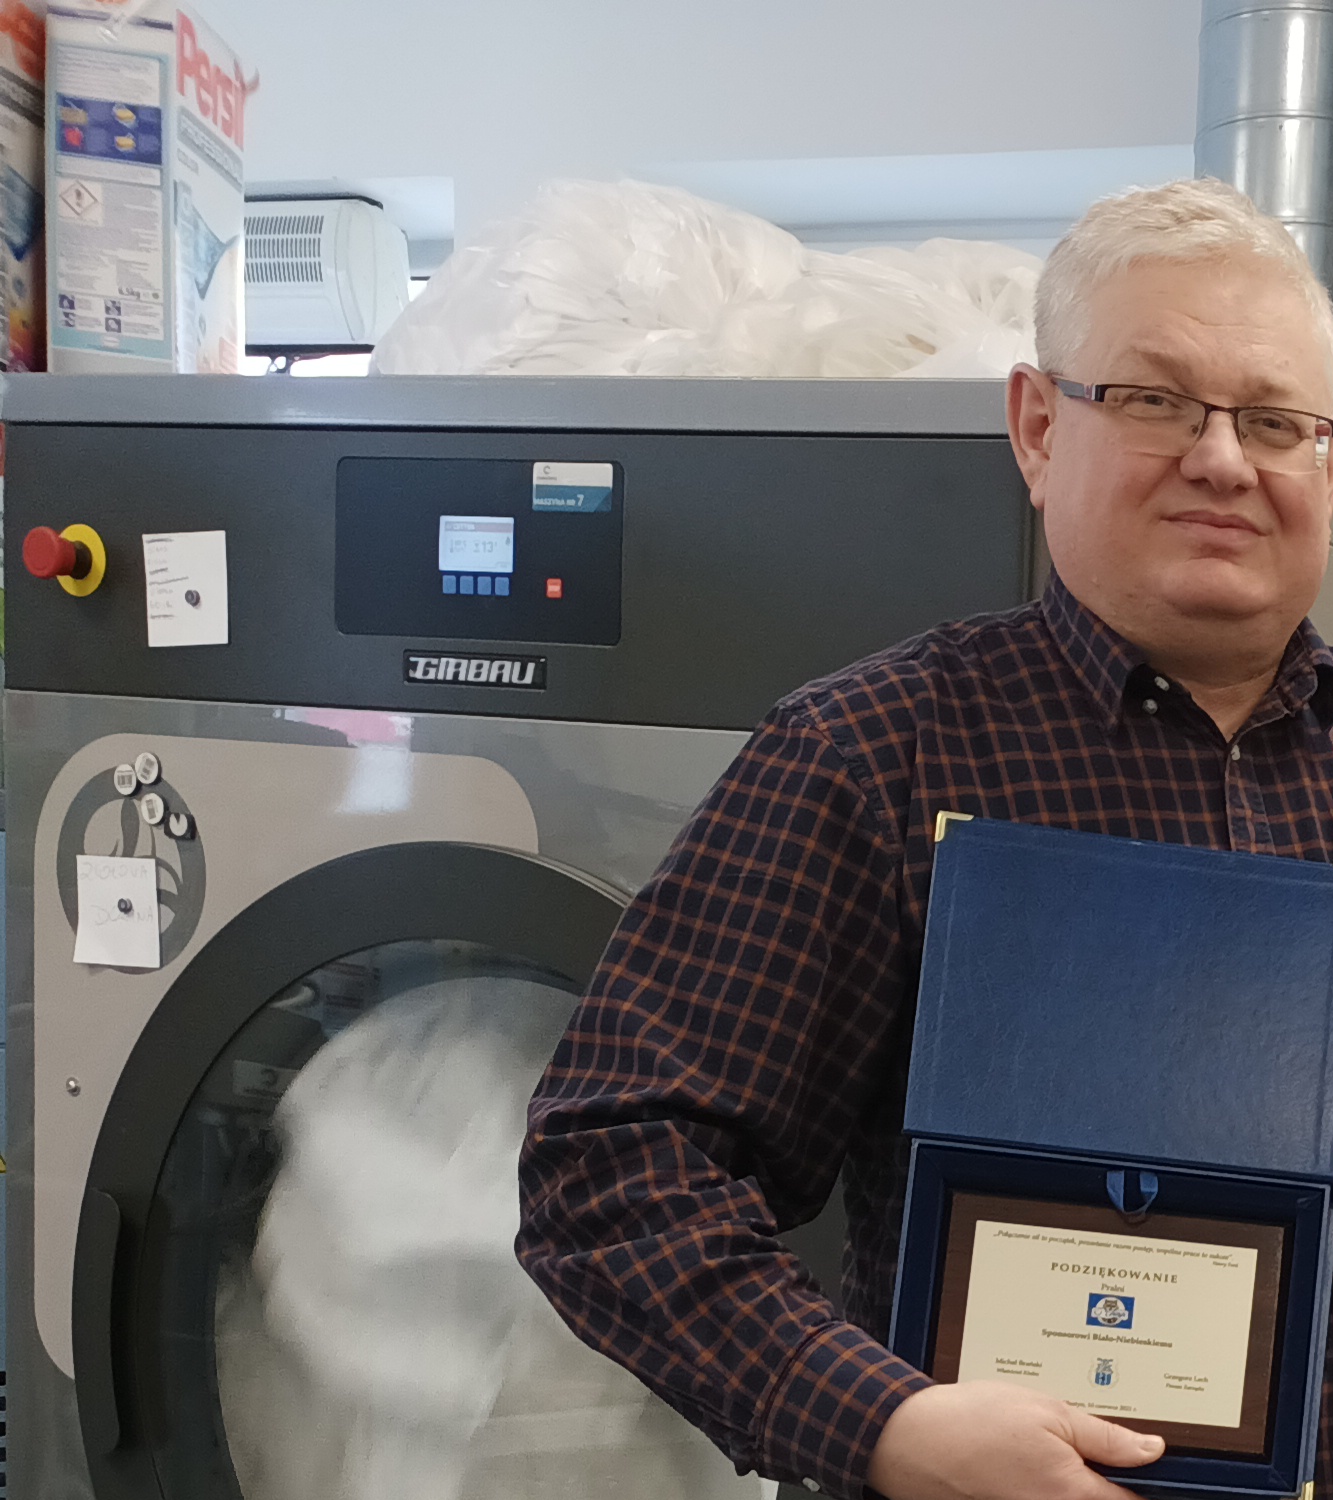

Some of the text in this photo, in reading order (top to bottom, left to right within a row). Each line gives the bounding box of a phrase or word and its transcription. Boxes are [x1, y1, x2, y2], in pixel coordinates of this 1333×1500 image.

[176, 9, 244, 152] Persil
[577, 493, 585, 507] 7
[411, 656, 536, 685] GIRBAU
[1050, 1262, 1178, 1284] PODZIĘKOWANIE
[1101, 1282, 1125, 1293] Pralni
